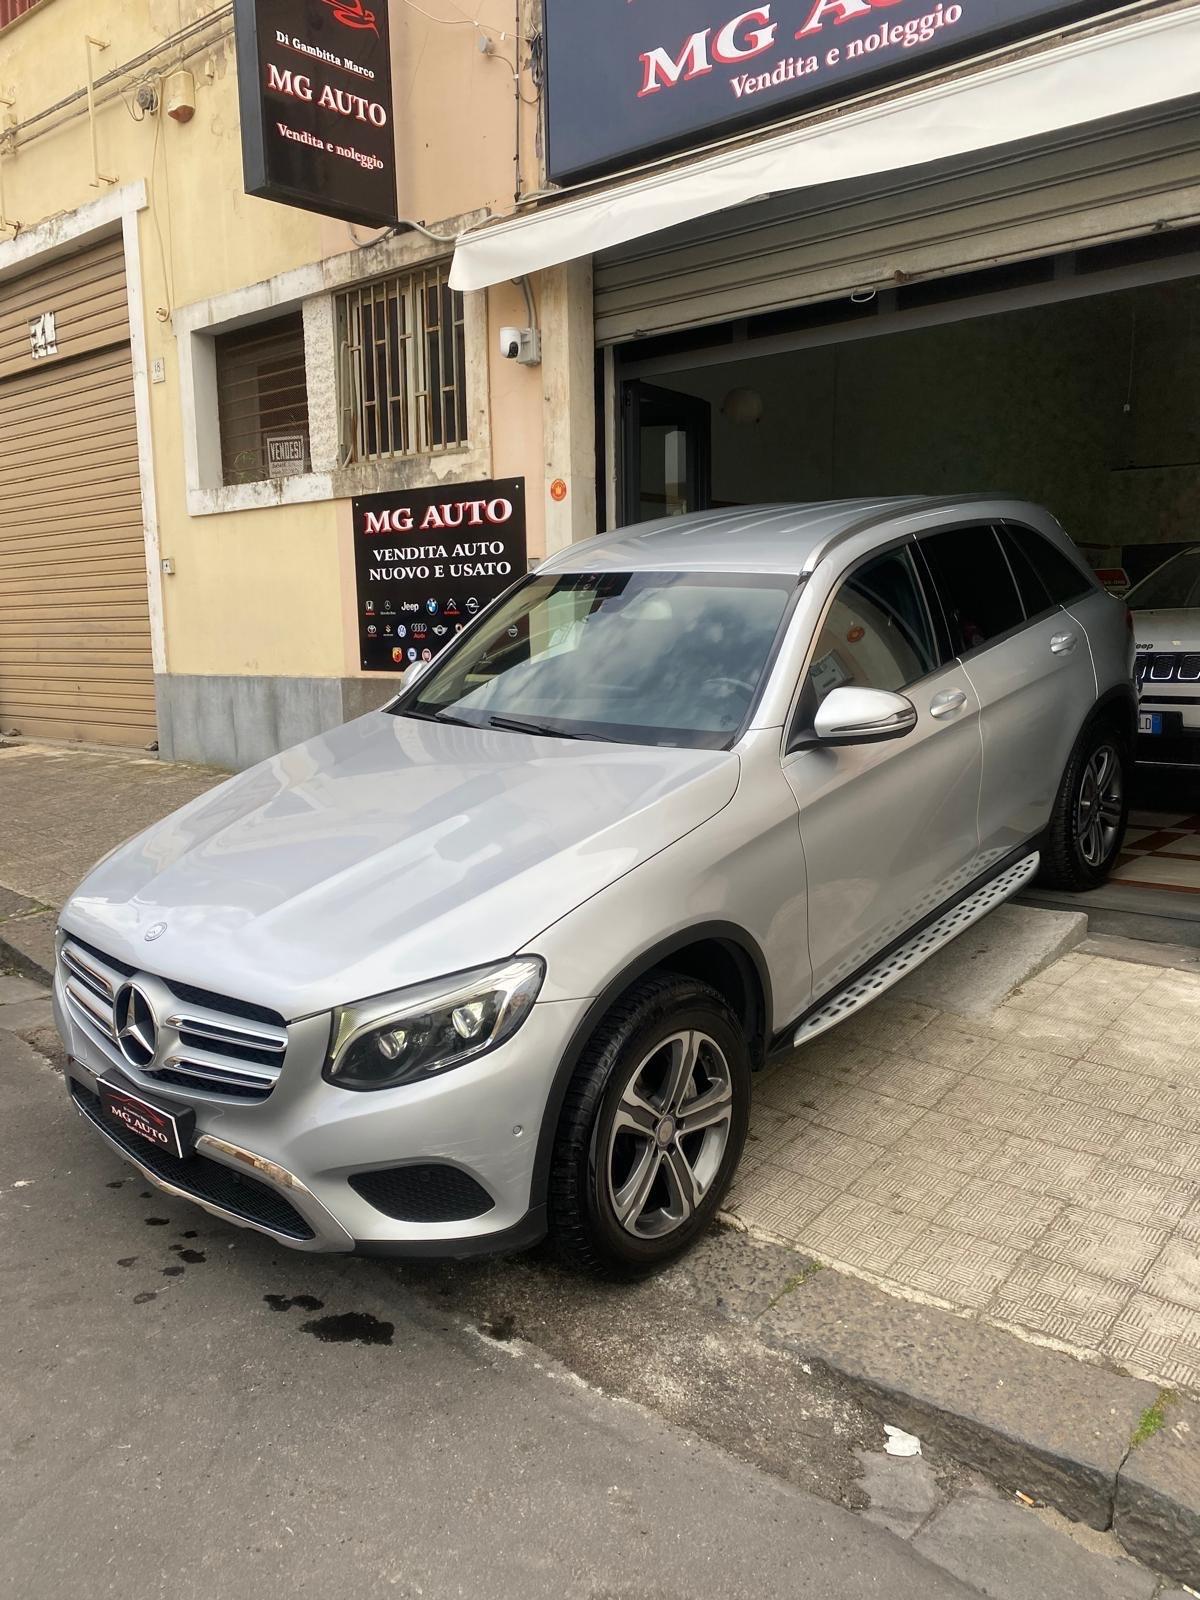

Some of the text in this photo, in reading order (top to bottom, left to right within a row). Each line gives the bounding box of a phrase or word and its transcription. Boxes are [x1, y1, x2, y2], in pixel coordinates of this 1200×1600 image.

[276, 31, 375, 79] Di Gambitta Marco
[638, 3, 778, 98] MG
[730, 56, 819, 99] Vendita
[826, 47, 840, 66] e
[847, 3, 963, 60] noleggio
[266, 63, 387, 128] MG AUTO
[276, 122, 384, 170] Vendita e noleggio
[270, 441, 302, 461] VENDESI
[364, 498, 513, 535] MG AUTO
[373, 541, 505, 562] VENDITA AUTO
[369, 561, 512, 581] NUOVO E USATO
[401, 601, 420, 613] Jeep
[1135, 643, 1154, 651] eep
[111, 1105, 131, 1123] MG
[134, 1119, 168, 1143] AUTO
